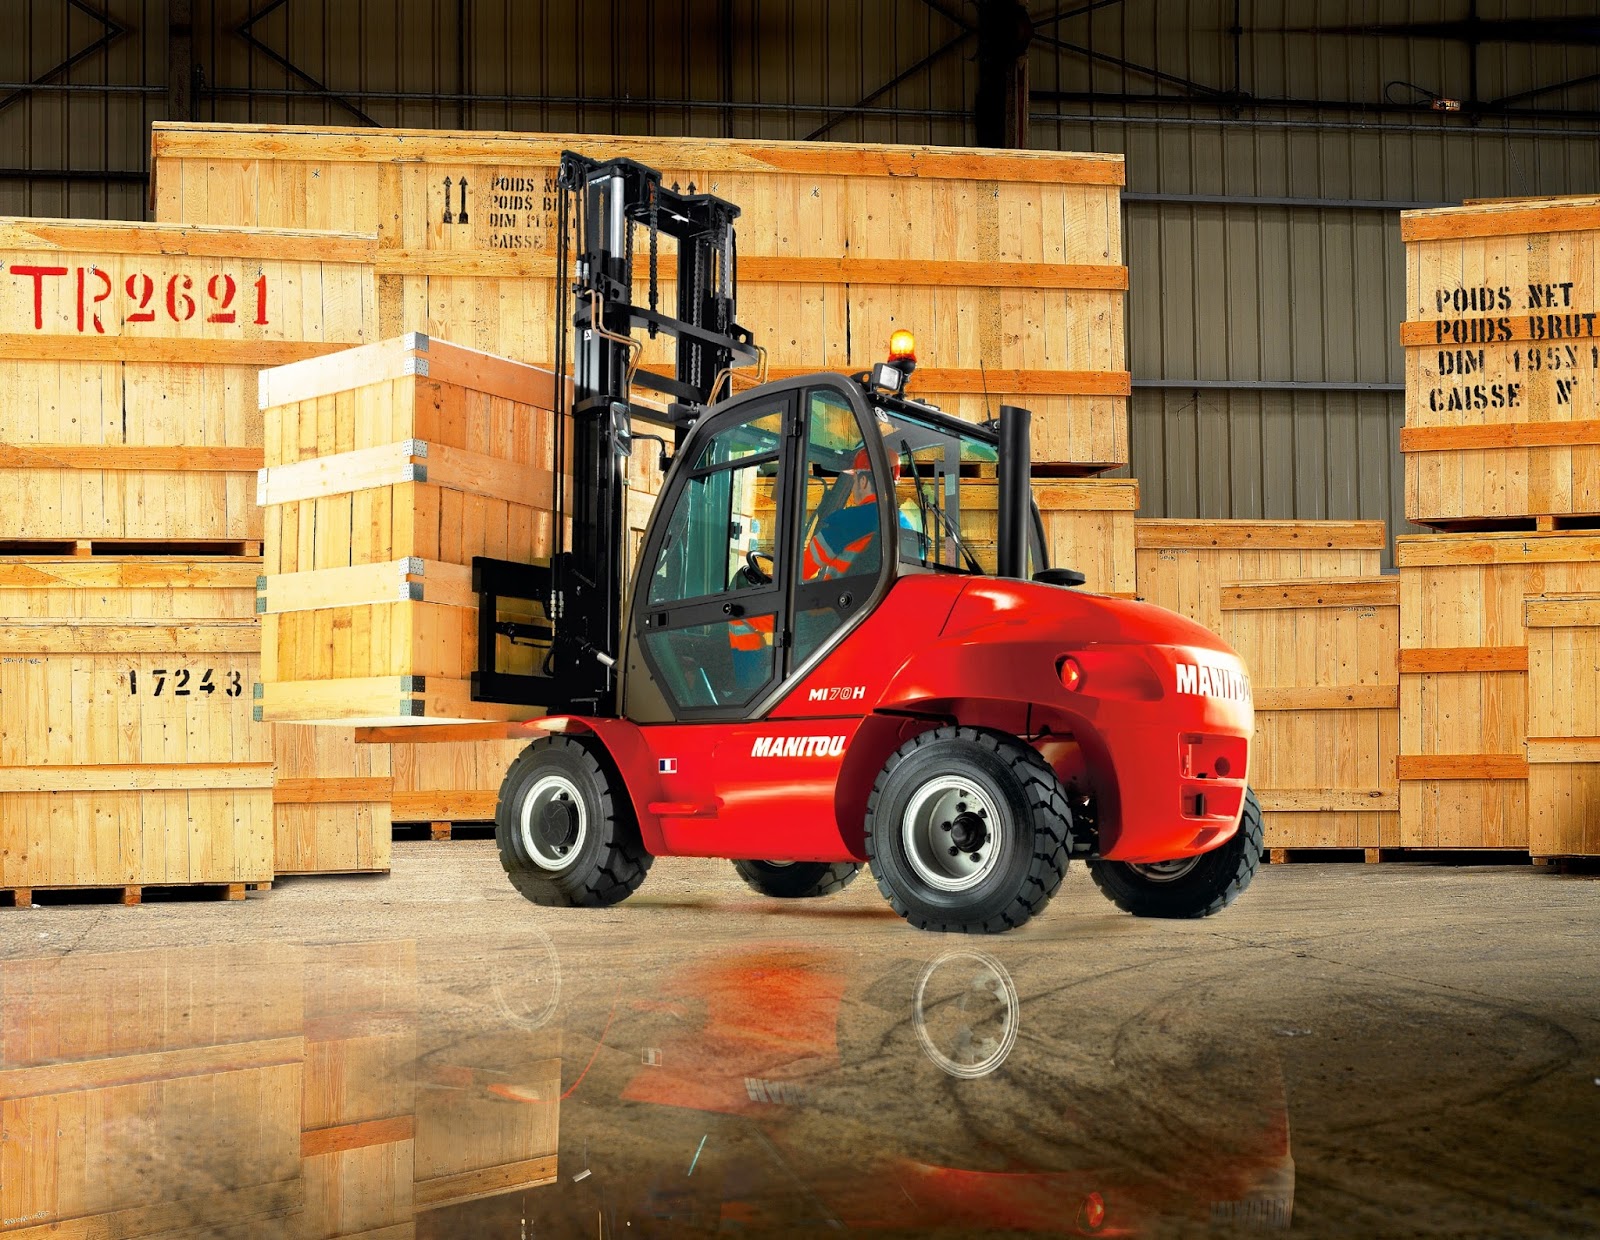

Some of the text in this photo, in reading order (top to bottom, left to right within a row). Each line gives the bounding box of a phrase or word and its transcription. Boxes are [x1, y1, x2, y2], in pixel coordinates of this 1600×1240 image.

[490, 177, 534, 192] POIDS
[489, 213, 516, 228] DIM
[489, 233, 543, 249] CAISSE
[1436, 282, 1574, 313] POIDS NET
[1436, 313, 1597, 343] POIDS BRUT
[1438, 350, 1484, 375] DIM
[1429, 383, 1520, 412] CAISSE
[129, 669, 242, 697] 17243
[751, 735, 846, 758] MANITOU
